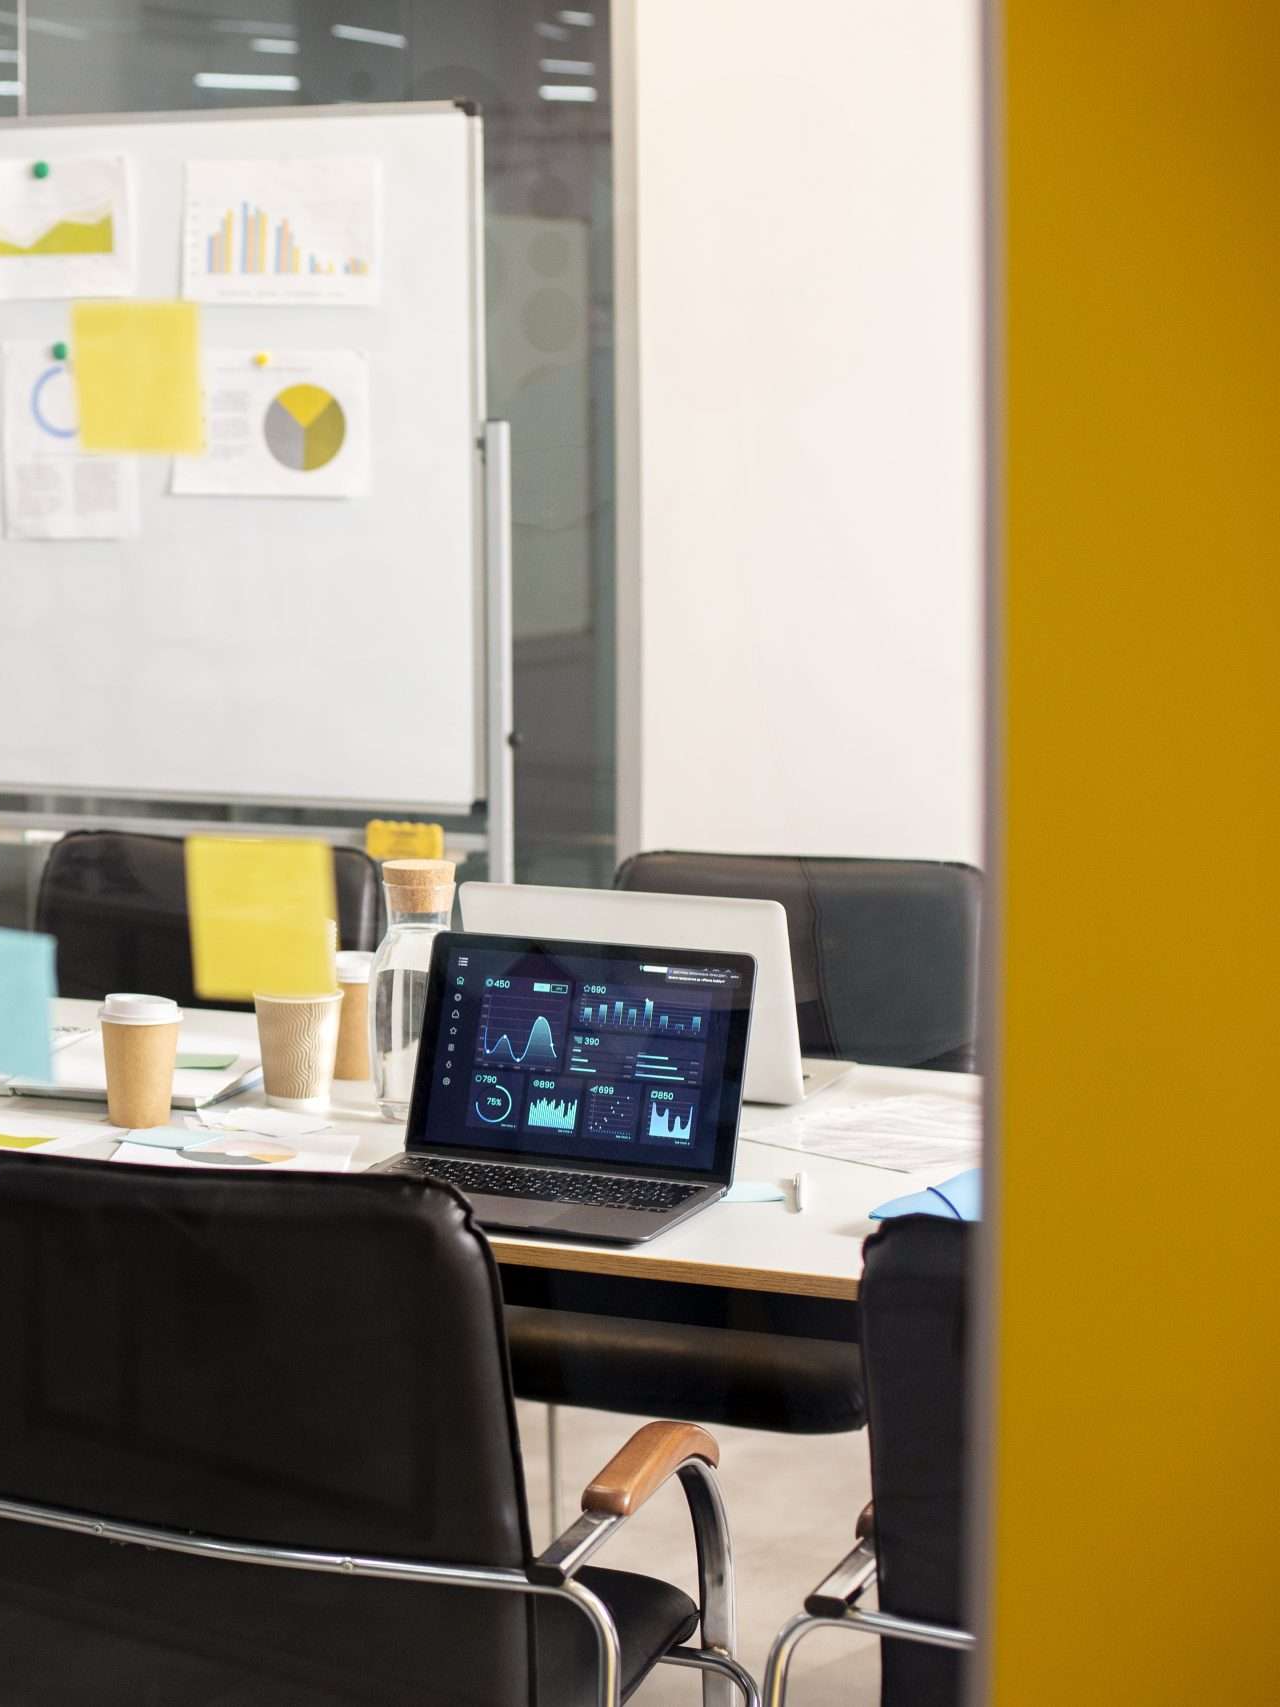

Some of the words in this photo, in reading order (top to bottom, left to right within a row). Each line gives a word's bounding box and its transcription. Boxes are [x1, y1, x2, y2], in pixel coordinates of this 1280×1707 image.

[494, 980, 510, 989] 450
[591, 985, 606, 994] 690
[584, 1037, 600, 1046] 390
[482, 1075, 497, 1084] 790
[539, 1080, 555, 1089] 890
[598, 1086, 614, 1095] 699
[657, 1092, 674, 1100] 850
[486, 1097, 502, 1106] 75%
